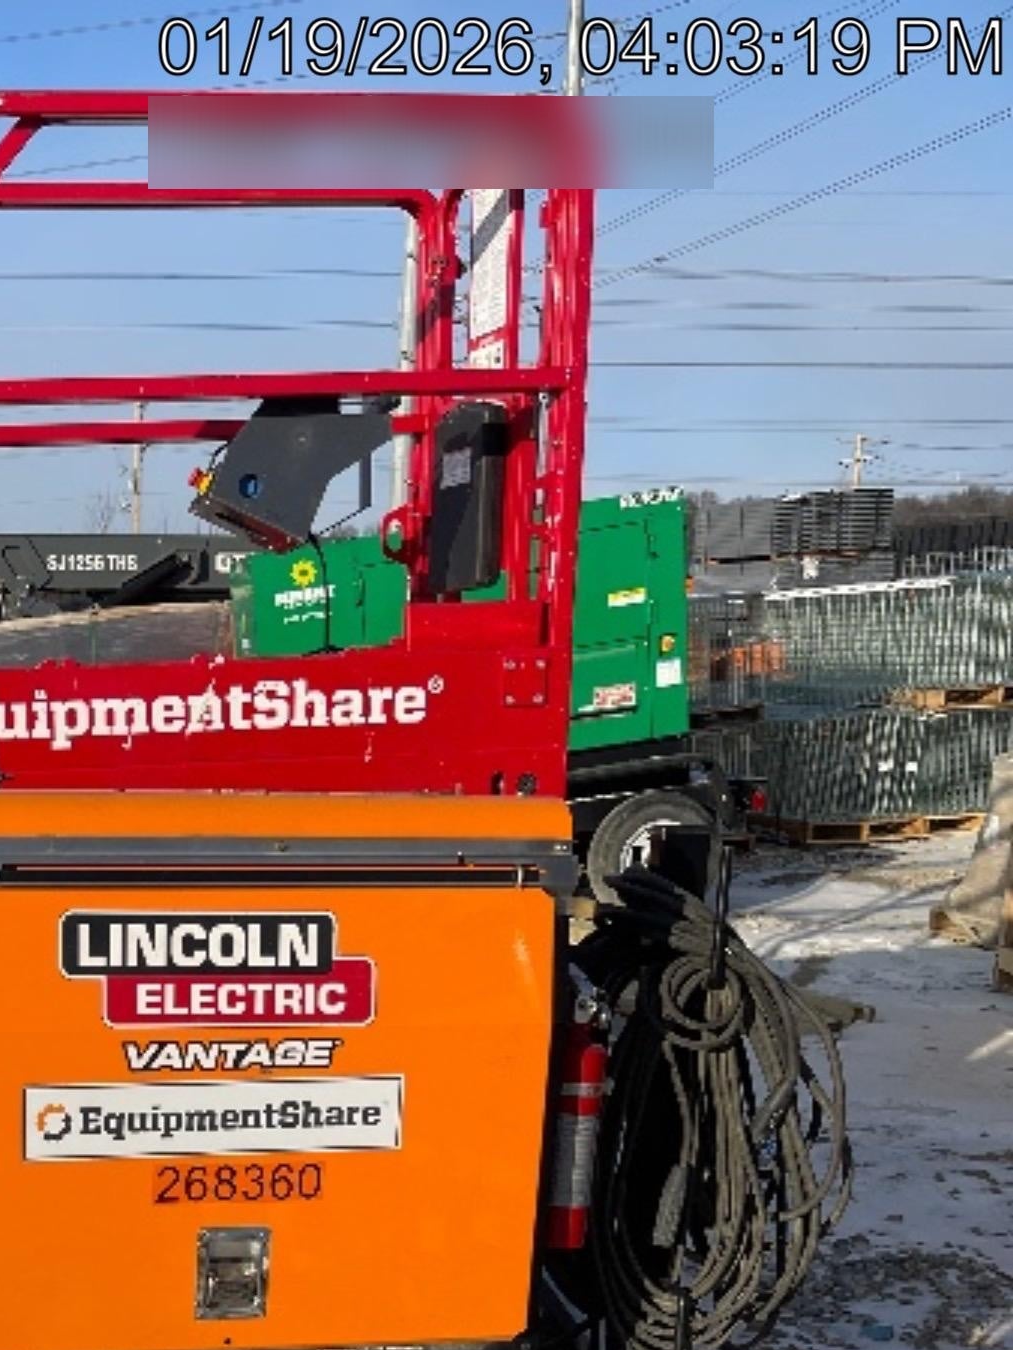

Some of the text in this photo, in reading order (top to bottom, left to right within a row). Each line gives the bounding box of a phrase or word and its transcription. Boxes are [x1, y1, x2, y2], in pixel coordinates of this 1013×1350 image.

[77, 923, 319, 968] LINCOLN
[135, 983, 347, 1016] ELECTRIC
[123, 1038, 336, 1072] VANTAGE
[79, 1100, 382, 1141] EquipmentShare
[154, 1163, 322, 1204] 268360
